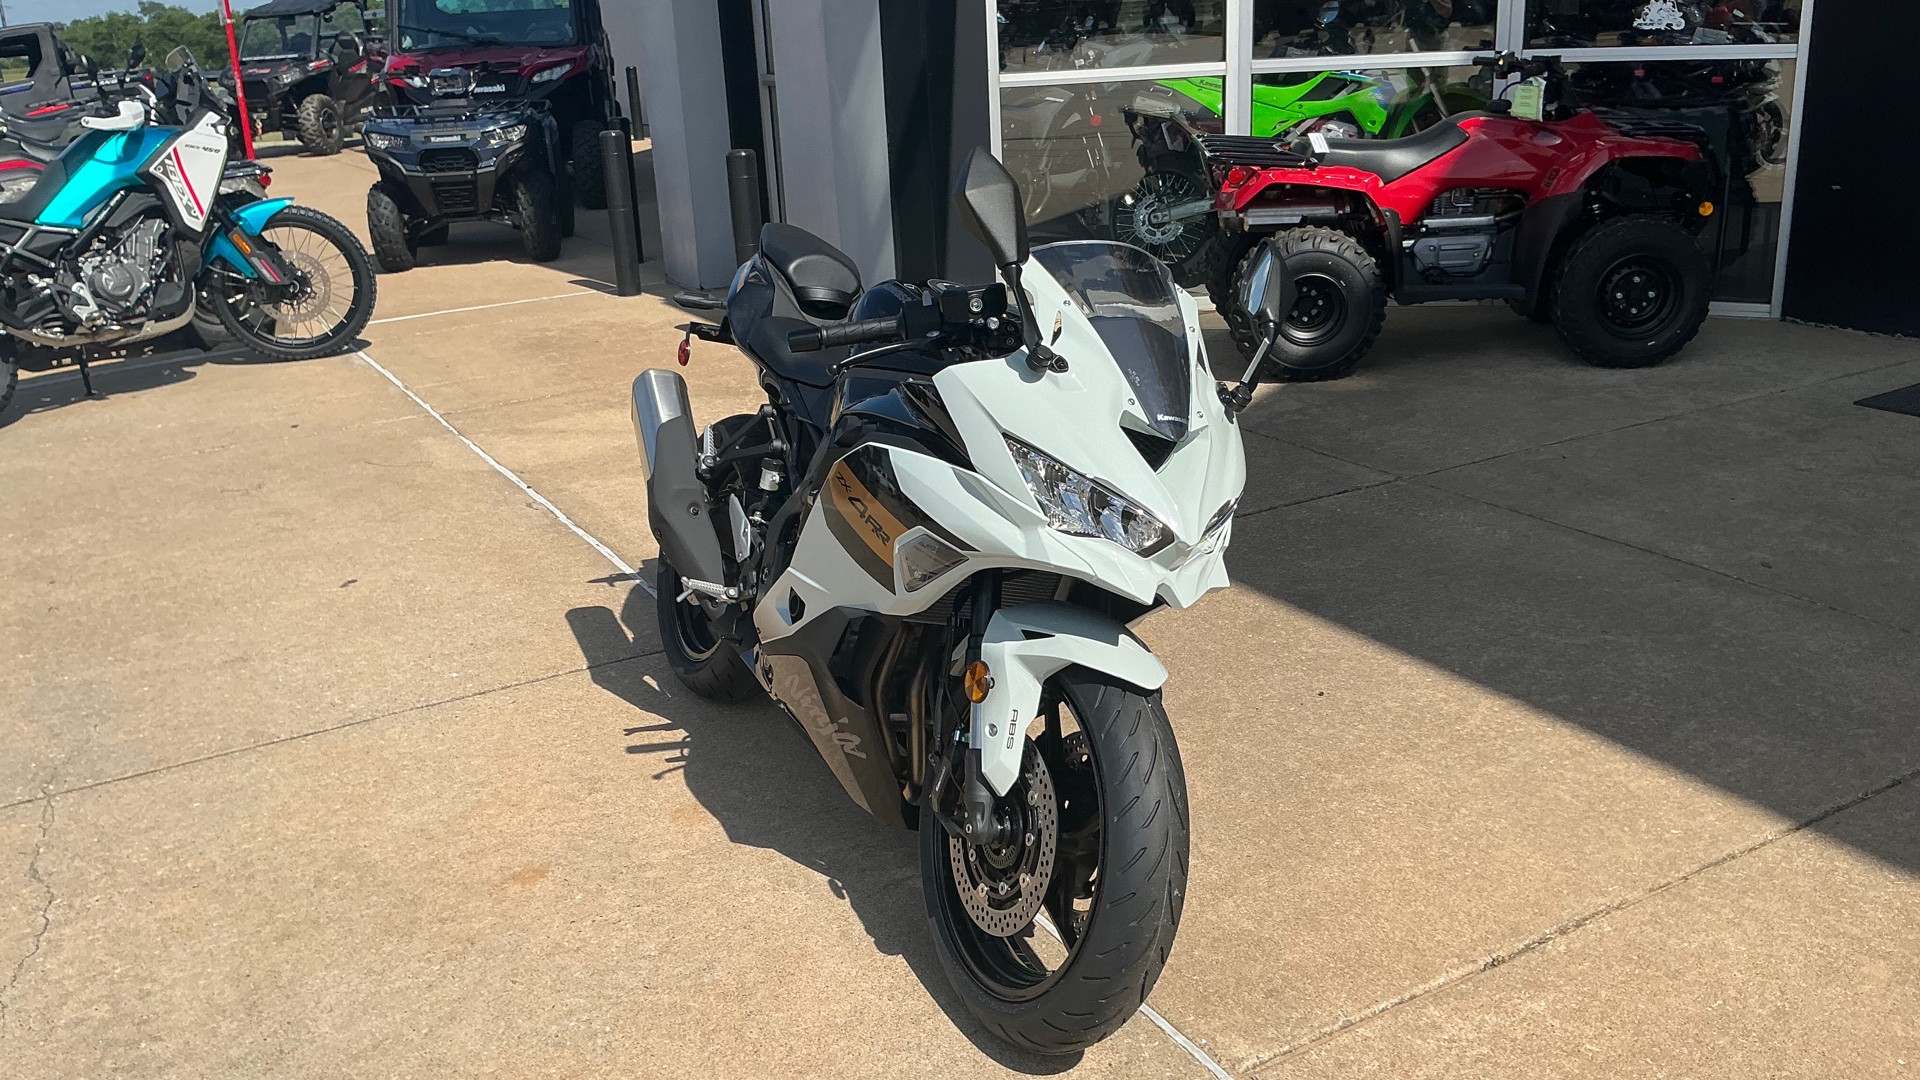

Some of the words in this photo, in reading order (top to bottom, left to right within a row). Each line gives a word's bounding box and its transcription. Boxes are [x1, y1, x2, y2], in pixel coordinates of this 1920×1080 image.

[473, 83, 506, 94] wasaki
[1199, 79, 1222, 88] Kawas
[784, 673, 867, 759] Ninja
[1006, 708, 1019, 750] ABS
